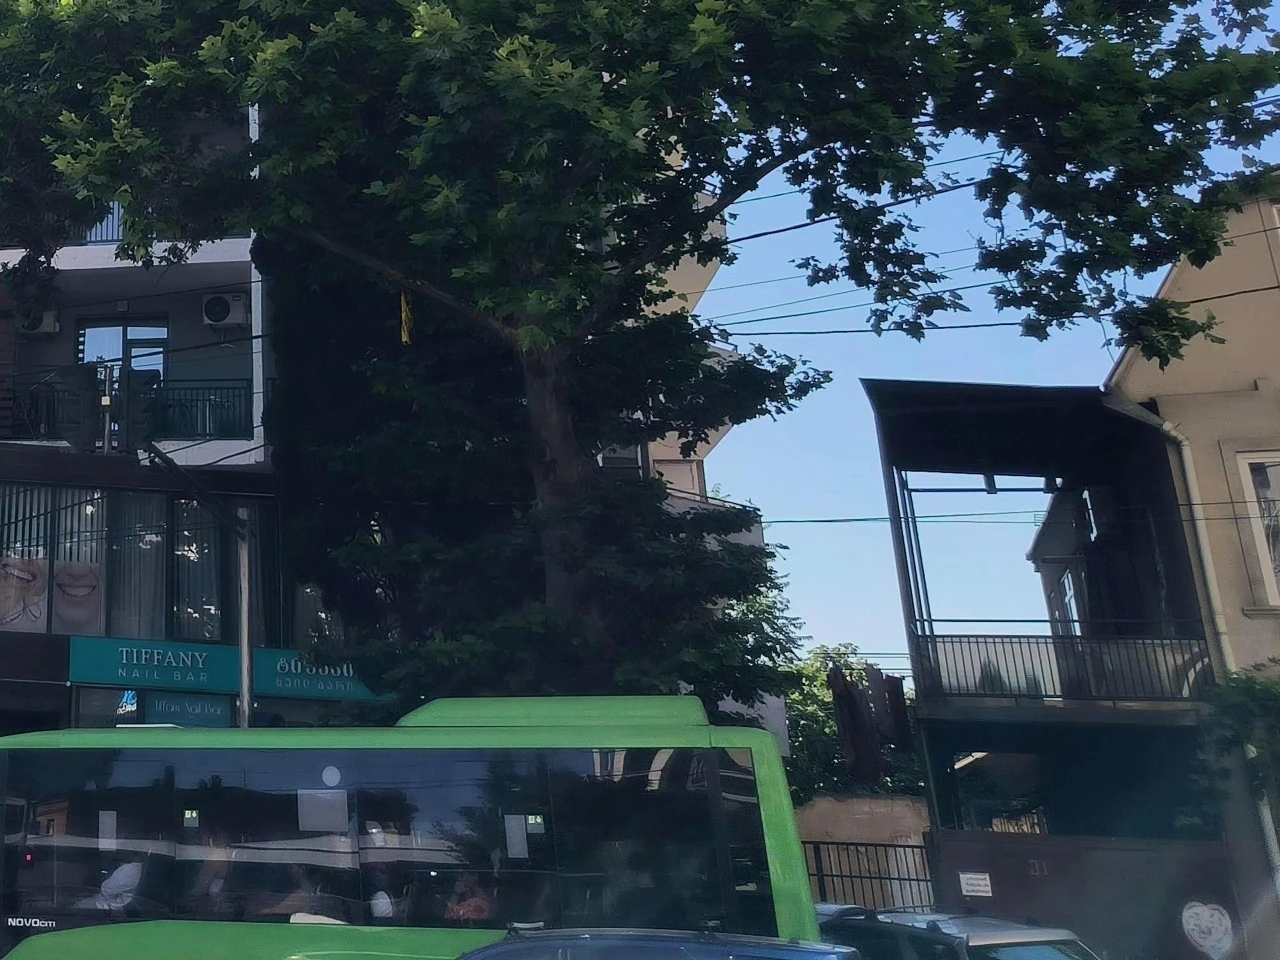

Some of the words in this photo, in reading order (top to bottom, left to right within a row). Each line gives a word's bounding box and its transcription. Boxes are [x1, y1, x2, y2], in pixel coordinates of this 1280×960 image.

[118, 647, 208, 668] TIFFANY
[118, 668, 160, 680] NAIL
[173, 670, 208, 682] BAR
[317, 680, 354, 691] ბარი
